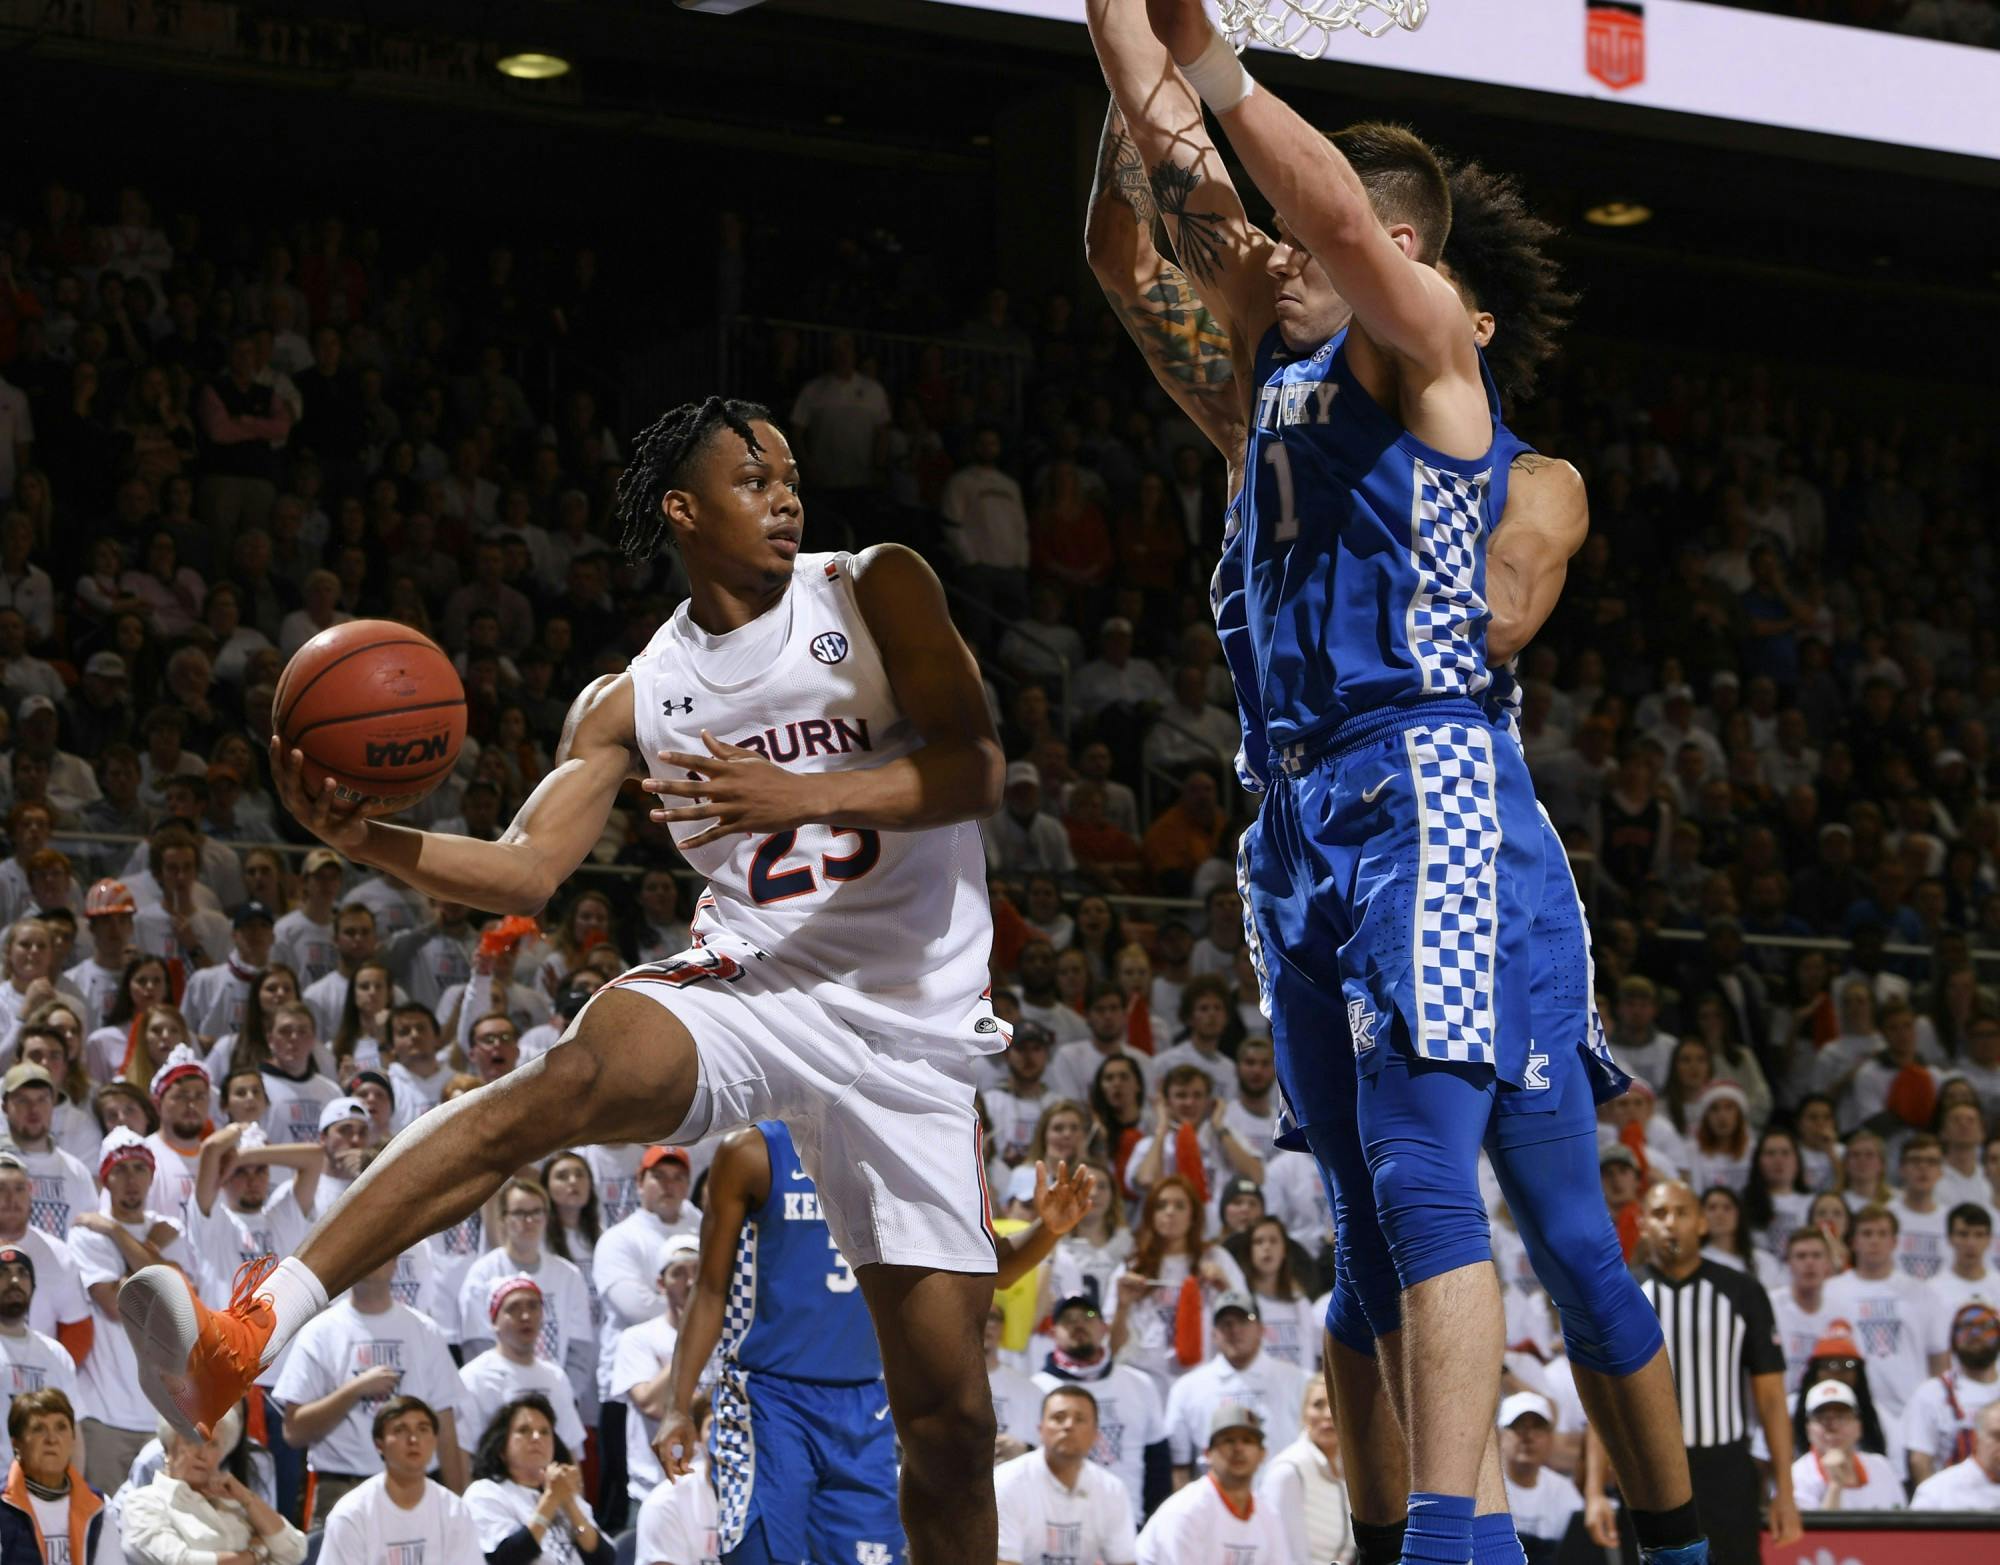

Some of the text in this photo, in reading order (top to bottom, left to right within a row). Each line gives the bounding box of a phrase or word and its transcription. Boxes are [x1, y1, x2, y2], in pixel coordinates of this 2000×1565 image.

[1263, 441, 1300, 542] 1
[812, 633, 846, 662] SEC
[366, 733, 449, 767] NCAA
[711, 718, 873, 767] BURN
